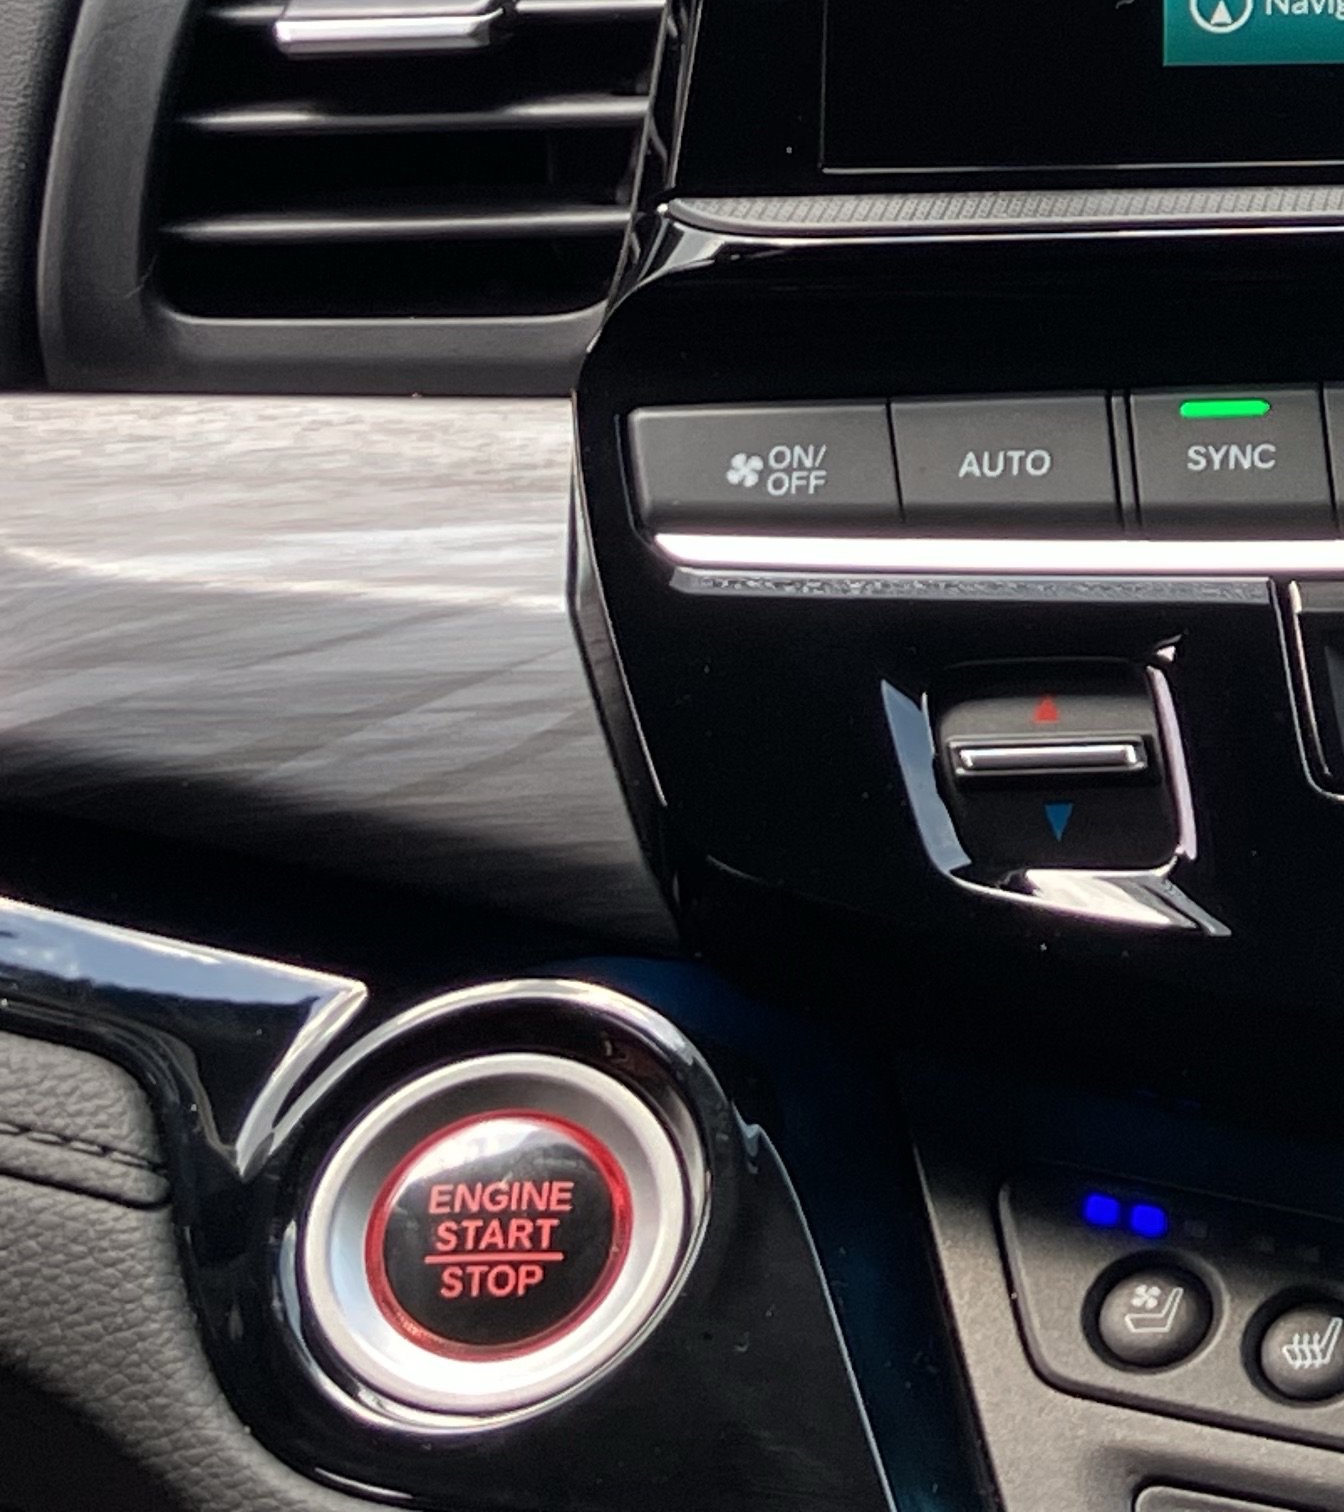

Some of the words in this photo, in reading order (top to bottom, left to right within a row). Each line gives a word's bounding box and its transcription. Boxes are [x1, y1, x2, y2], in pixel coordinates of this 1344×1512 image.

[768, 444, 827, 470] ON/
[958, 449, 1051, 478] AUTO
[1187, 443, 1276, 471] SYNC
[766, 470, 827, 496] OFF
[428, 1180, 575, 1216] ENGINE
[435, 1218, 560, 1253] START
[440, 1264, 545, 1299] STOP
